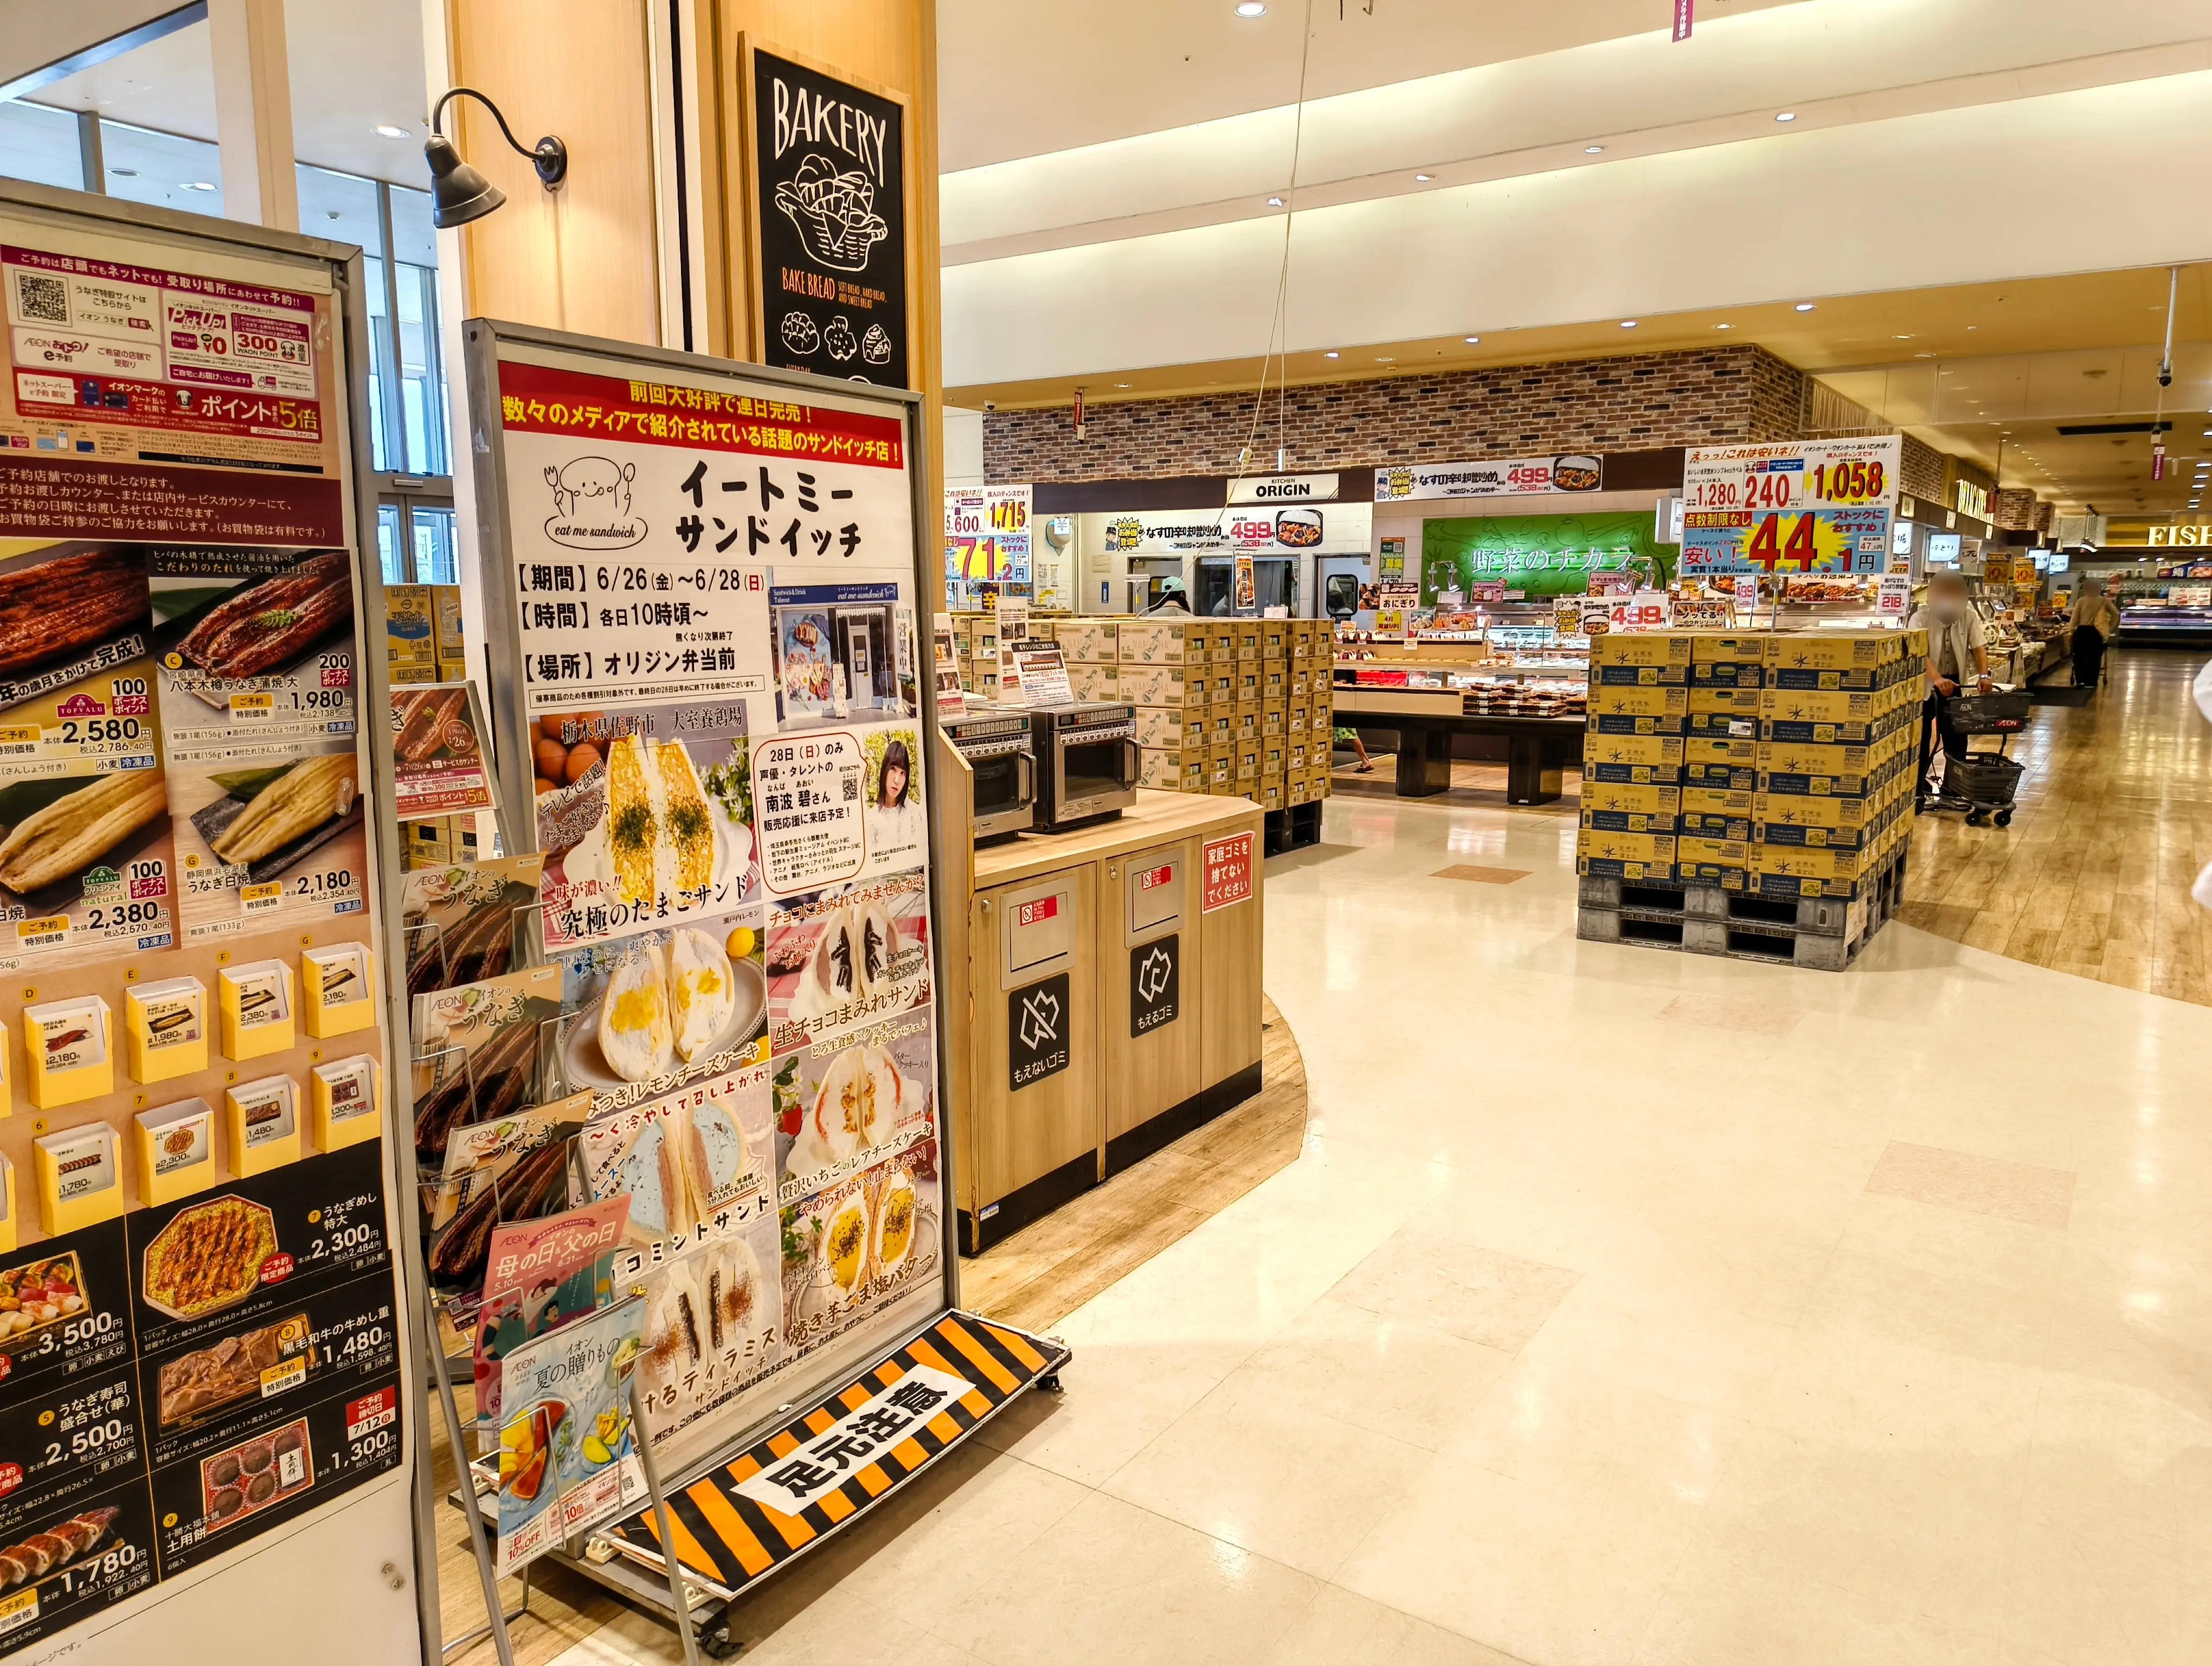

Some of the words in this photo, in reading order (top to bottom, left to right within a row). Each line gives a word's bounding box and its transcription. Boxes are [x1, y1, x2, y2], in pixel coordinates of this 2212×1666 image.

[773, 77, 888, 188] BAKERY
[782, 266, 806, 298] BAKE
[807, 269, 835, 302] BREAD
[93, 298, 132, 311] こちらから
[237, 334, 278, 352] 300
[237, 348, 258, 357] WAON
[259, 350, 279, 359] POINT
[201, 395, 272, 422] ポイント
[279, 400, 318, 430] 5倍
[680, 460, 855, 512] イートミー
[1256, 483, 1310, 498] ORIGIN
[1745, 473, 1790, 509] 240
[1814, 460, 1883, 502] 1,058
[954, 515, 979, 533] 600
[990, 501, 1026, 529] 1,715
[1685, 511, 1751, 528] 点数制限なし
[1833, 510, 1884, 521] ストックに
[554, 524, 570, 537] eat
[572, 527, 588, 537] me
[589, 523, 636, 539] sandwich
[675, 515, 862, 559] サンドイッチ
[1001, 535, 1027, 543] ストックに
[1471, 546, 1635, 575] 野菜のチカラ
[1382, 599, 1416, 608] おにぎり
[675, 631, 734, 643] 無くなり次第終了
[319, 653, 350, 670] 200
[604, 648, 736, 674] オリジン弁当前
[112, 678, 145, 696] 100
[561, 713, 655, 745] 栃木県佐野市
[1207, 838, 1249, 866] 家庭ゴミを
[130, 861, 163, 880] 100
[1210, 860, 1246, 885] 捨てない
[188, 874, 250, 894] うなぎ白焼
[442, 873, 508, 912] うなぎ
[1207, 878, 1249, 904] でください
[80, 892, 128, 907] natural
[561, 874, 748, 942] 究極のたまごサンド
[462, 992, 526, 1036] うなぎ
[774, 979, 929, 1049] 生チョコまみれサンド
[1137, 1004, 1173, 1030] もえるゴミ
[1013, 1049, 1066, 1084] もえないゴミ
[491, 1122, 557, 1163] うなぎ
[323, 1193, 377, 1218] うなぎめし
[324, 1214, 348, 1232] 特大
[765, 1380, 950, 1500] 足元注意
